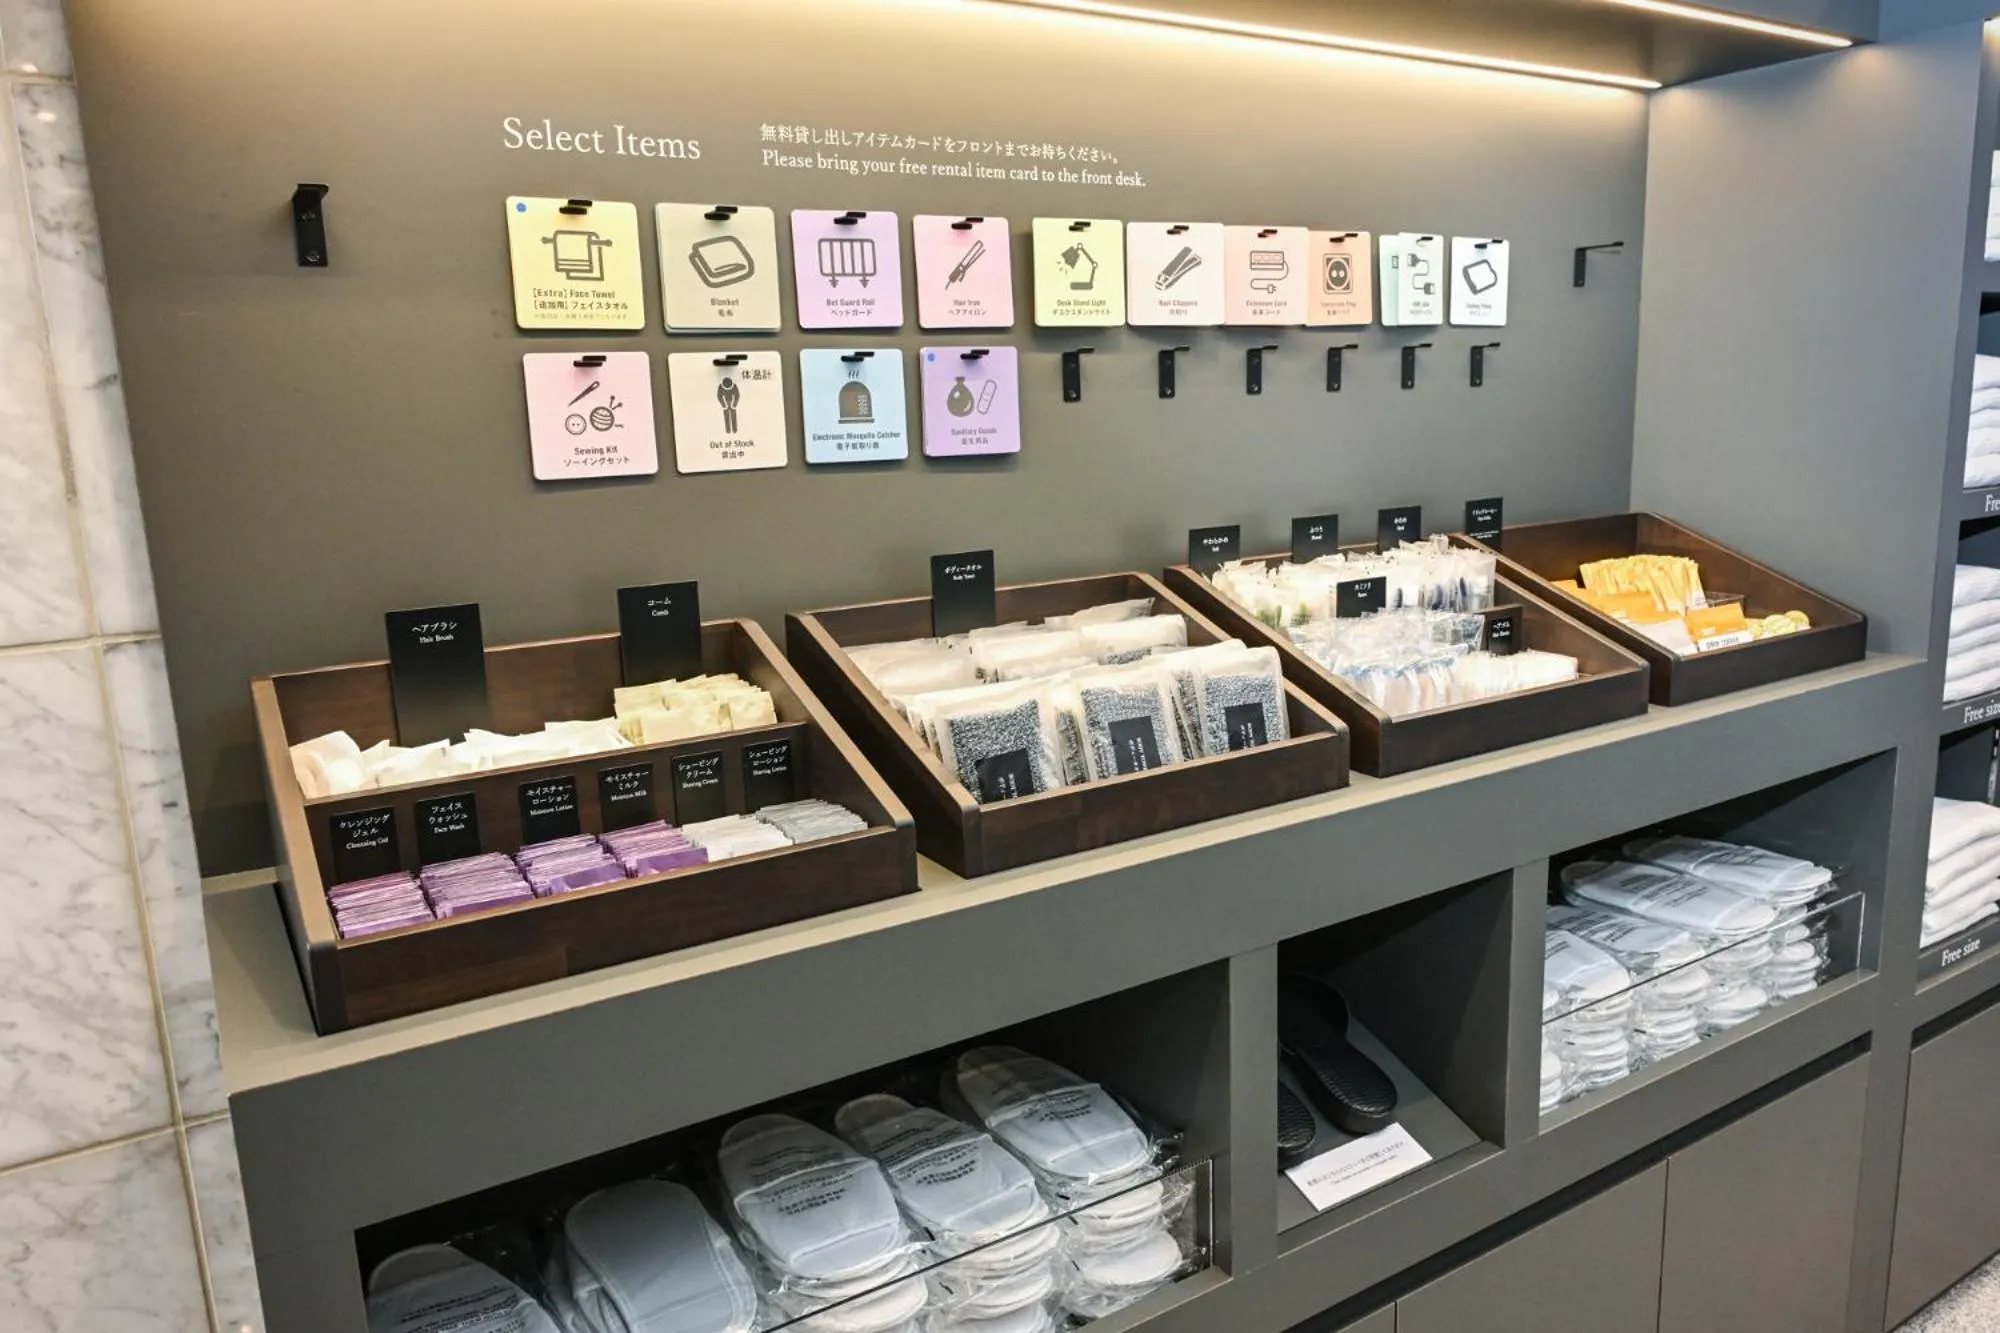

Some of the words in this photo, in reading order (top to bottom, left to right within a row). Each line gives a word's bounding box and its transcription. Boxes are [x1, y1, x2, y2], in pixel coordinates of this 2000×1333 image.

[503, 117, 605, 154] Select
[613, 124, 701, 160] Items
[760, 123, 1119, 164] 無料貸し出しアイテムカードをフロントまでお持ちください。
[763, 149, 812, 169] Please
[818, 152, 858, 176] bring
[862, 158, 895, 177] your
[899, 159, 928, 175] free
[932, 162, 972, 177] rental
[975, 164, 1005, 179] item
[1009, 166, 1038, 181] card
[1042, 169, 1055, 182] to
[1059, 169, 1078, 182] the
[1082, 170, 1112, 185] front
[1115, 171, 1147, 187] desk.
[570, 289, 589, 298] Face
[591, 289, 615, 298] Towel
[742, 369, 772, 380] 体温計
[574, 447, 604, 456] Sewing
[606, 446, 618, 455] Kit
[564, 457, 630, 468] ソーイングセット
[647, 596, 672, 606] コーム
[1963, 706, 1984, 724] Free
[431, 802, 463, 814] フェイス
[339, 813, 390, 829] クレンジング
[428, 812, 468, 825] ウォッシュ
[353, 827, 379, 838] ジェル
[1941, 949, 1962, 967] Free
[1963, 938, 1981, 956] size
